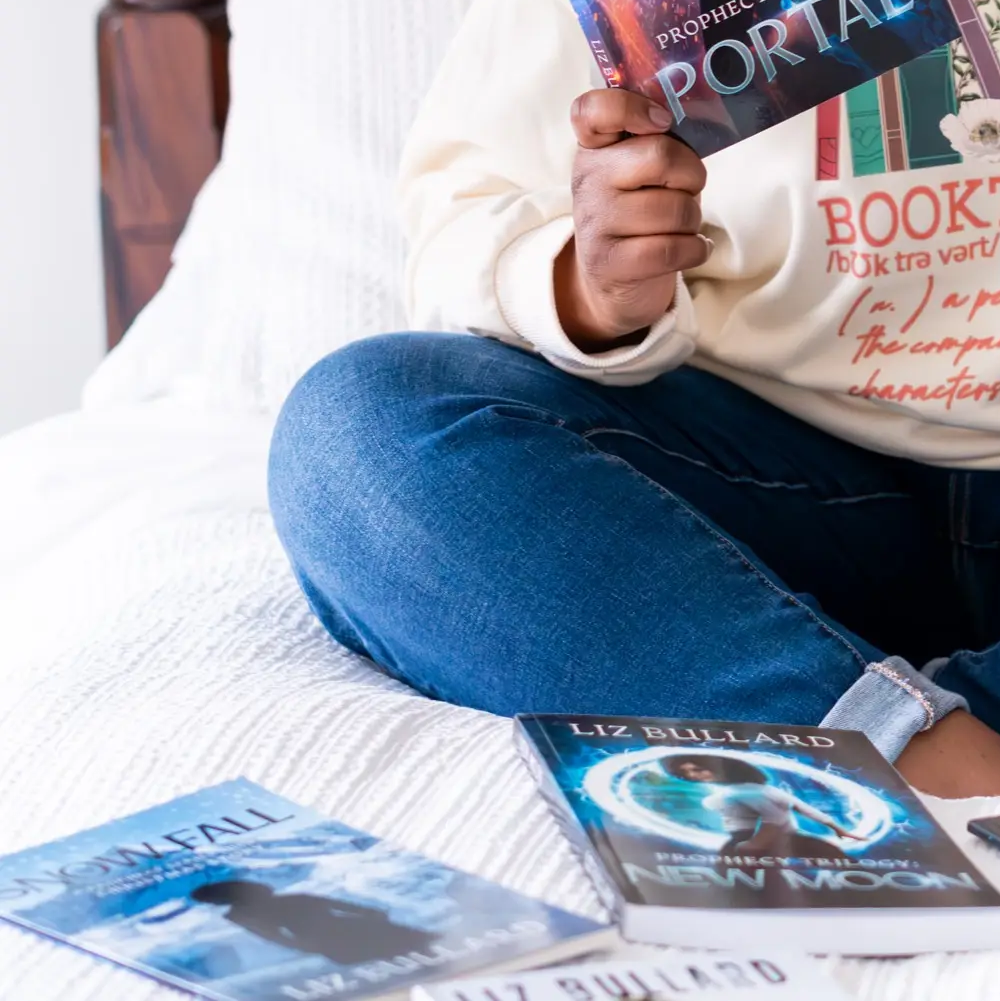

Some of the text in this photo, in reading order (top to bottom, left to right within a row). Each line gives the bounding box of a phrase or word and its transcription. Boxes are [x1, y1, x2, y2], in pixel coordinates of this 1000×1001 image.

[591, 40, 609, 63] LIZ
[942, 293, 970, 309] a
[852, 324, 907, 364] the
[569, 723, 835, 748] LIZ BULLARD
[655, 852, 793, 867] PROPHECY
[621, 862, 982, 892] NEW MOON
